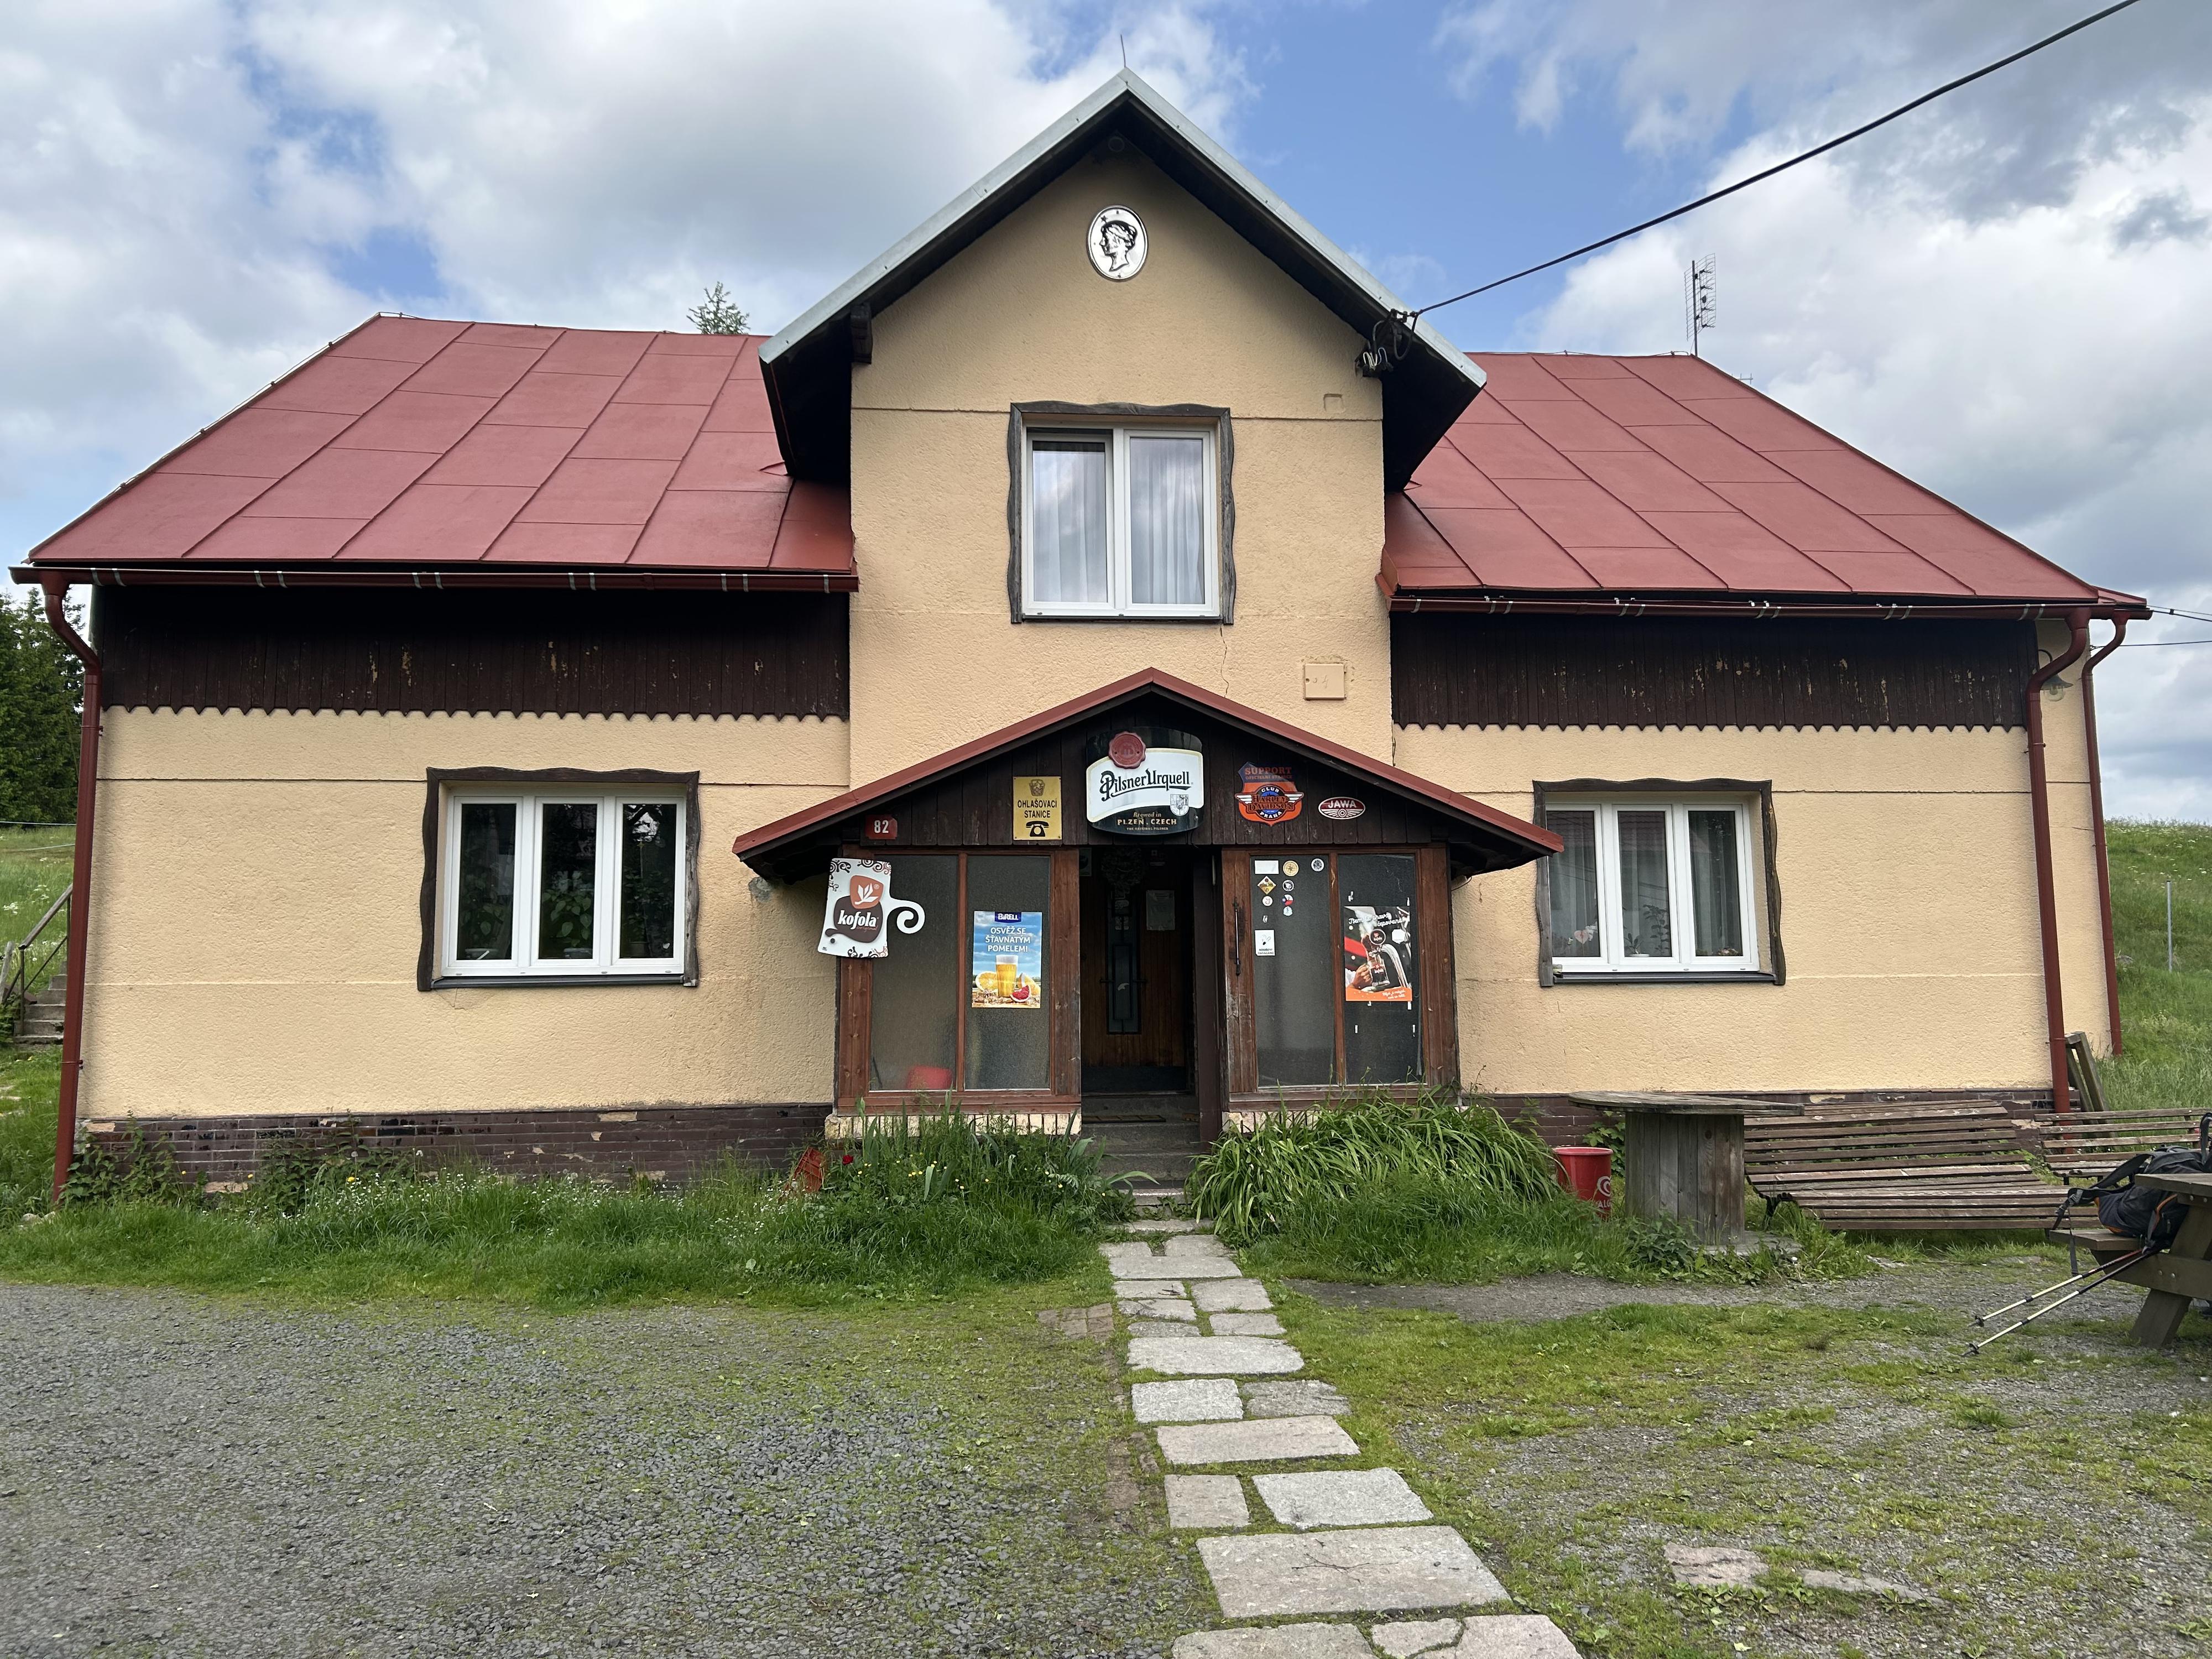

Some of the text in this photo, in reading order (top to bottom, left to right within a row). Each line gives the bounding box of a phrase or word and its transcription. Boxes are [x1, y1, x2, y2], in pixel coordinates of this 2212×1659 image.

[1099, 768, 1190, 802] Pilsner Urquell
[1018, 798, 1057, 808] OHLAŠOVACÍ
[1328, 800, 1357, 808] JAWA
[1024, 810, 1051, 818] STANICE
[874, 820, 889, 833] 82
[838, 910, 877, 930] kofola
[990, 926, 1015, 935] OSVĚŽ
[985, 935, 1030, 943] ŠŤAVNATÝM
